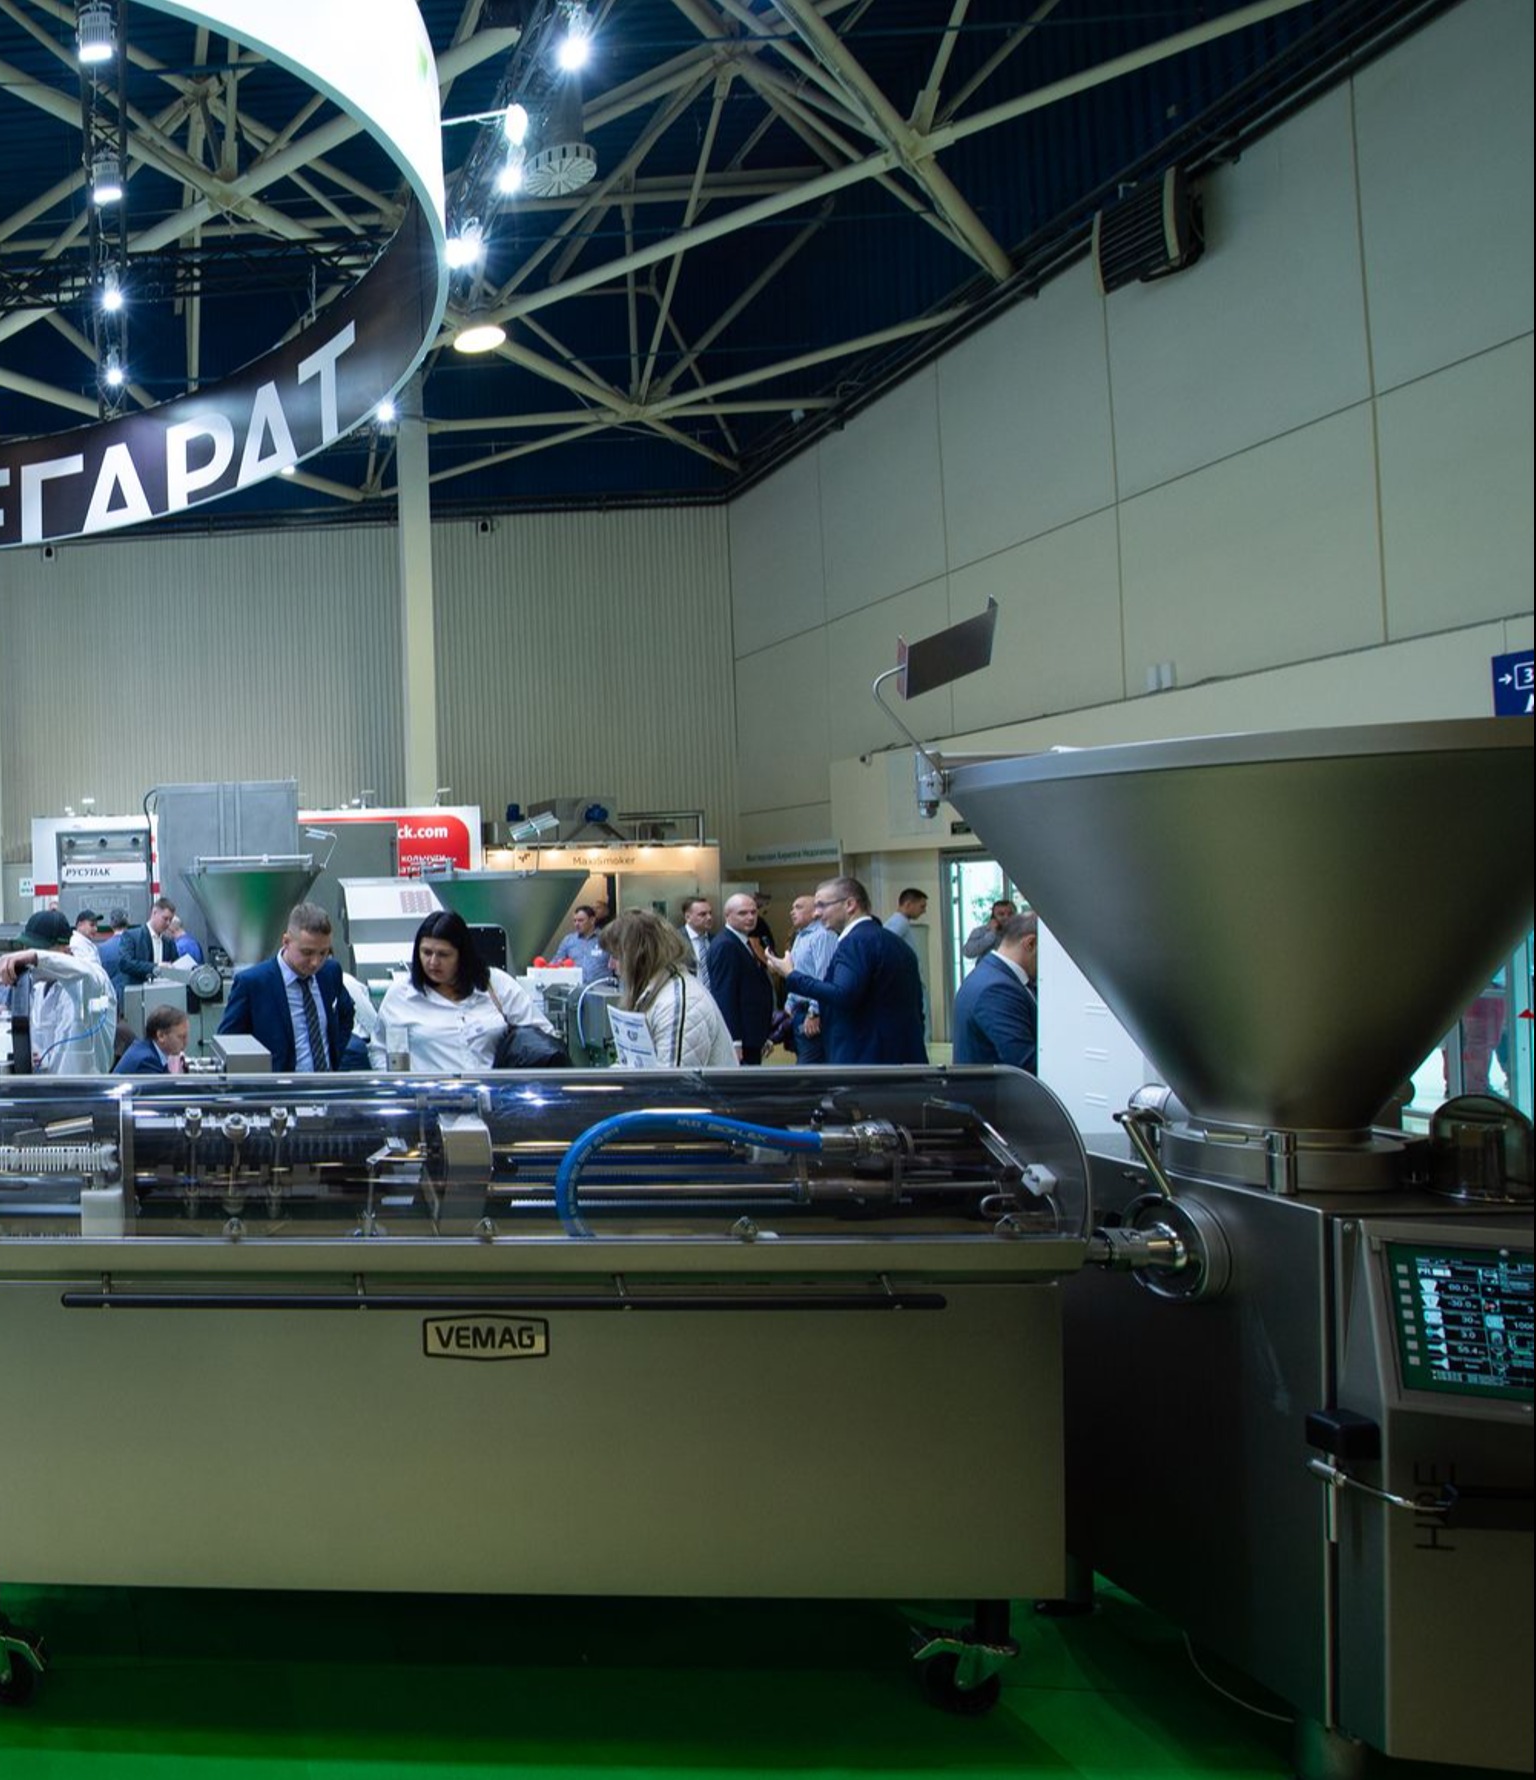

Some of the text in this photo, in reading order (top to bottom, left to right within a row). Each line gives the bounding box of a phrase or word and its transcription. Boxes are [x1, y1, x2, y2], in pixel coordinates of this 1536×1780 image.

[398, 825, 448, 839] ck.com
[65, 866, 111, 877] РУСУПАК
[435, 1326, 535, 1349] VEMAG
